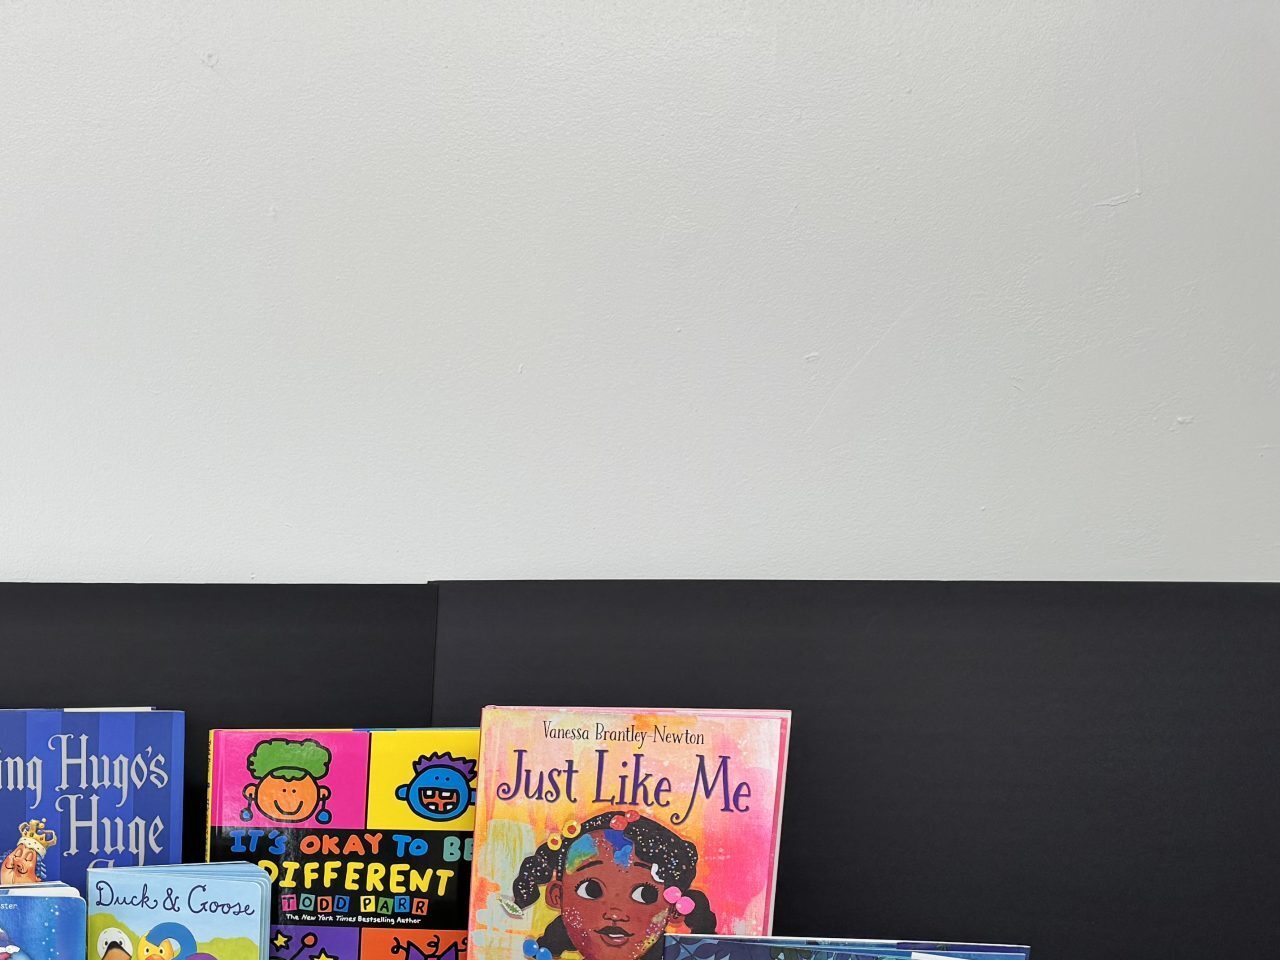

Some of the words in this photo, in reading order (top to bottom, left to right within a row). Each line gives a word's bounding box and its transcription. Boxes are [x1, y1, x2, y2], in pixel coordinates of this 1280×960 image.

[543, 720, 589, 740] Vanessa
[595, 722, 705, 749] Brantley-Newton
[48, 734, 169, 808] Hugo's
[496, 749, 579, 804] Just
[592, 749, 672, 807] Like
[670, 754, 751, 826] Me
[55, 793, 164, 866] Huge
[230, 830, 287, 852] IT'S
[300, 833, 383, 856] OKAY
[392, 834, 429, 857] TO
[257, 859, 455, 896] DIFFERENT
[95, 881, 158, 909] Duck
[163, 887, 180, 912] &
[187, 885, 255, 916] Goose
[282, 895, 349, 911] TODD
[361, 896, 427, 914] PARR
[357, 916, 395, 925] Bestselling
